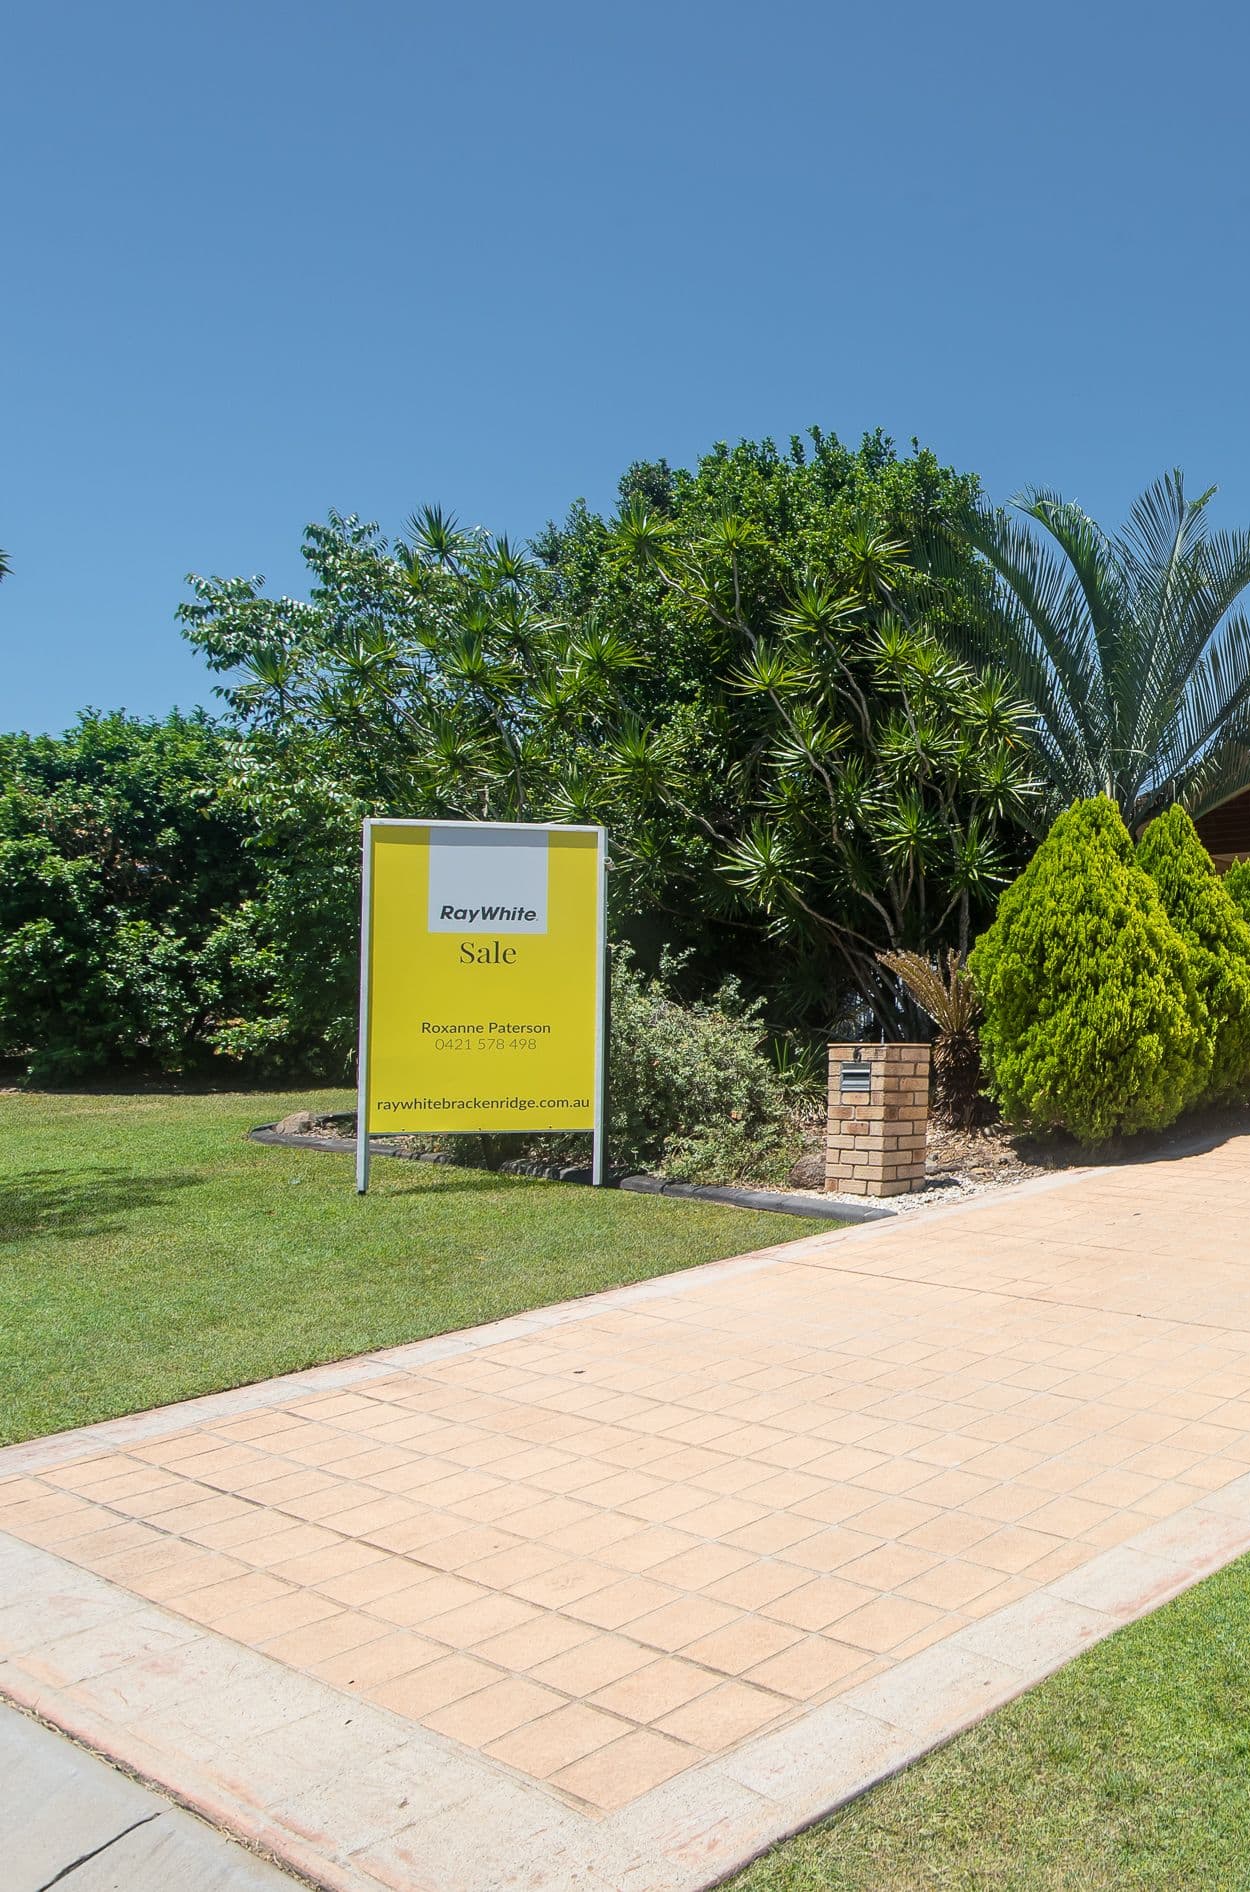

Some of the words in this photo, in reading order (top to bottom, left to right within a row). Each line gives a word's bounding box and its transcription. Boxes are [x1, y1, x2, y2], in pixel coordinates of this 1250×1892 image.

[460, 940, 517, 965] Sale
[421, 1022, 484, 1034] Roxanne
[488, 1022, 551, 1034] Paterson
[435, 1038, 471, 1050] 0421
[478, 1038, 505, 1050] 578
[509, 1038, 537, 1050] 498
[377, 1097, 590, 1112] raywhitebrackenridge.com.au
